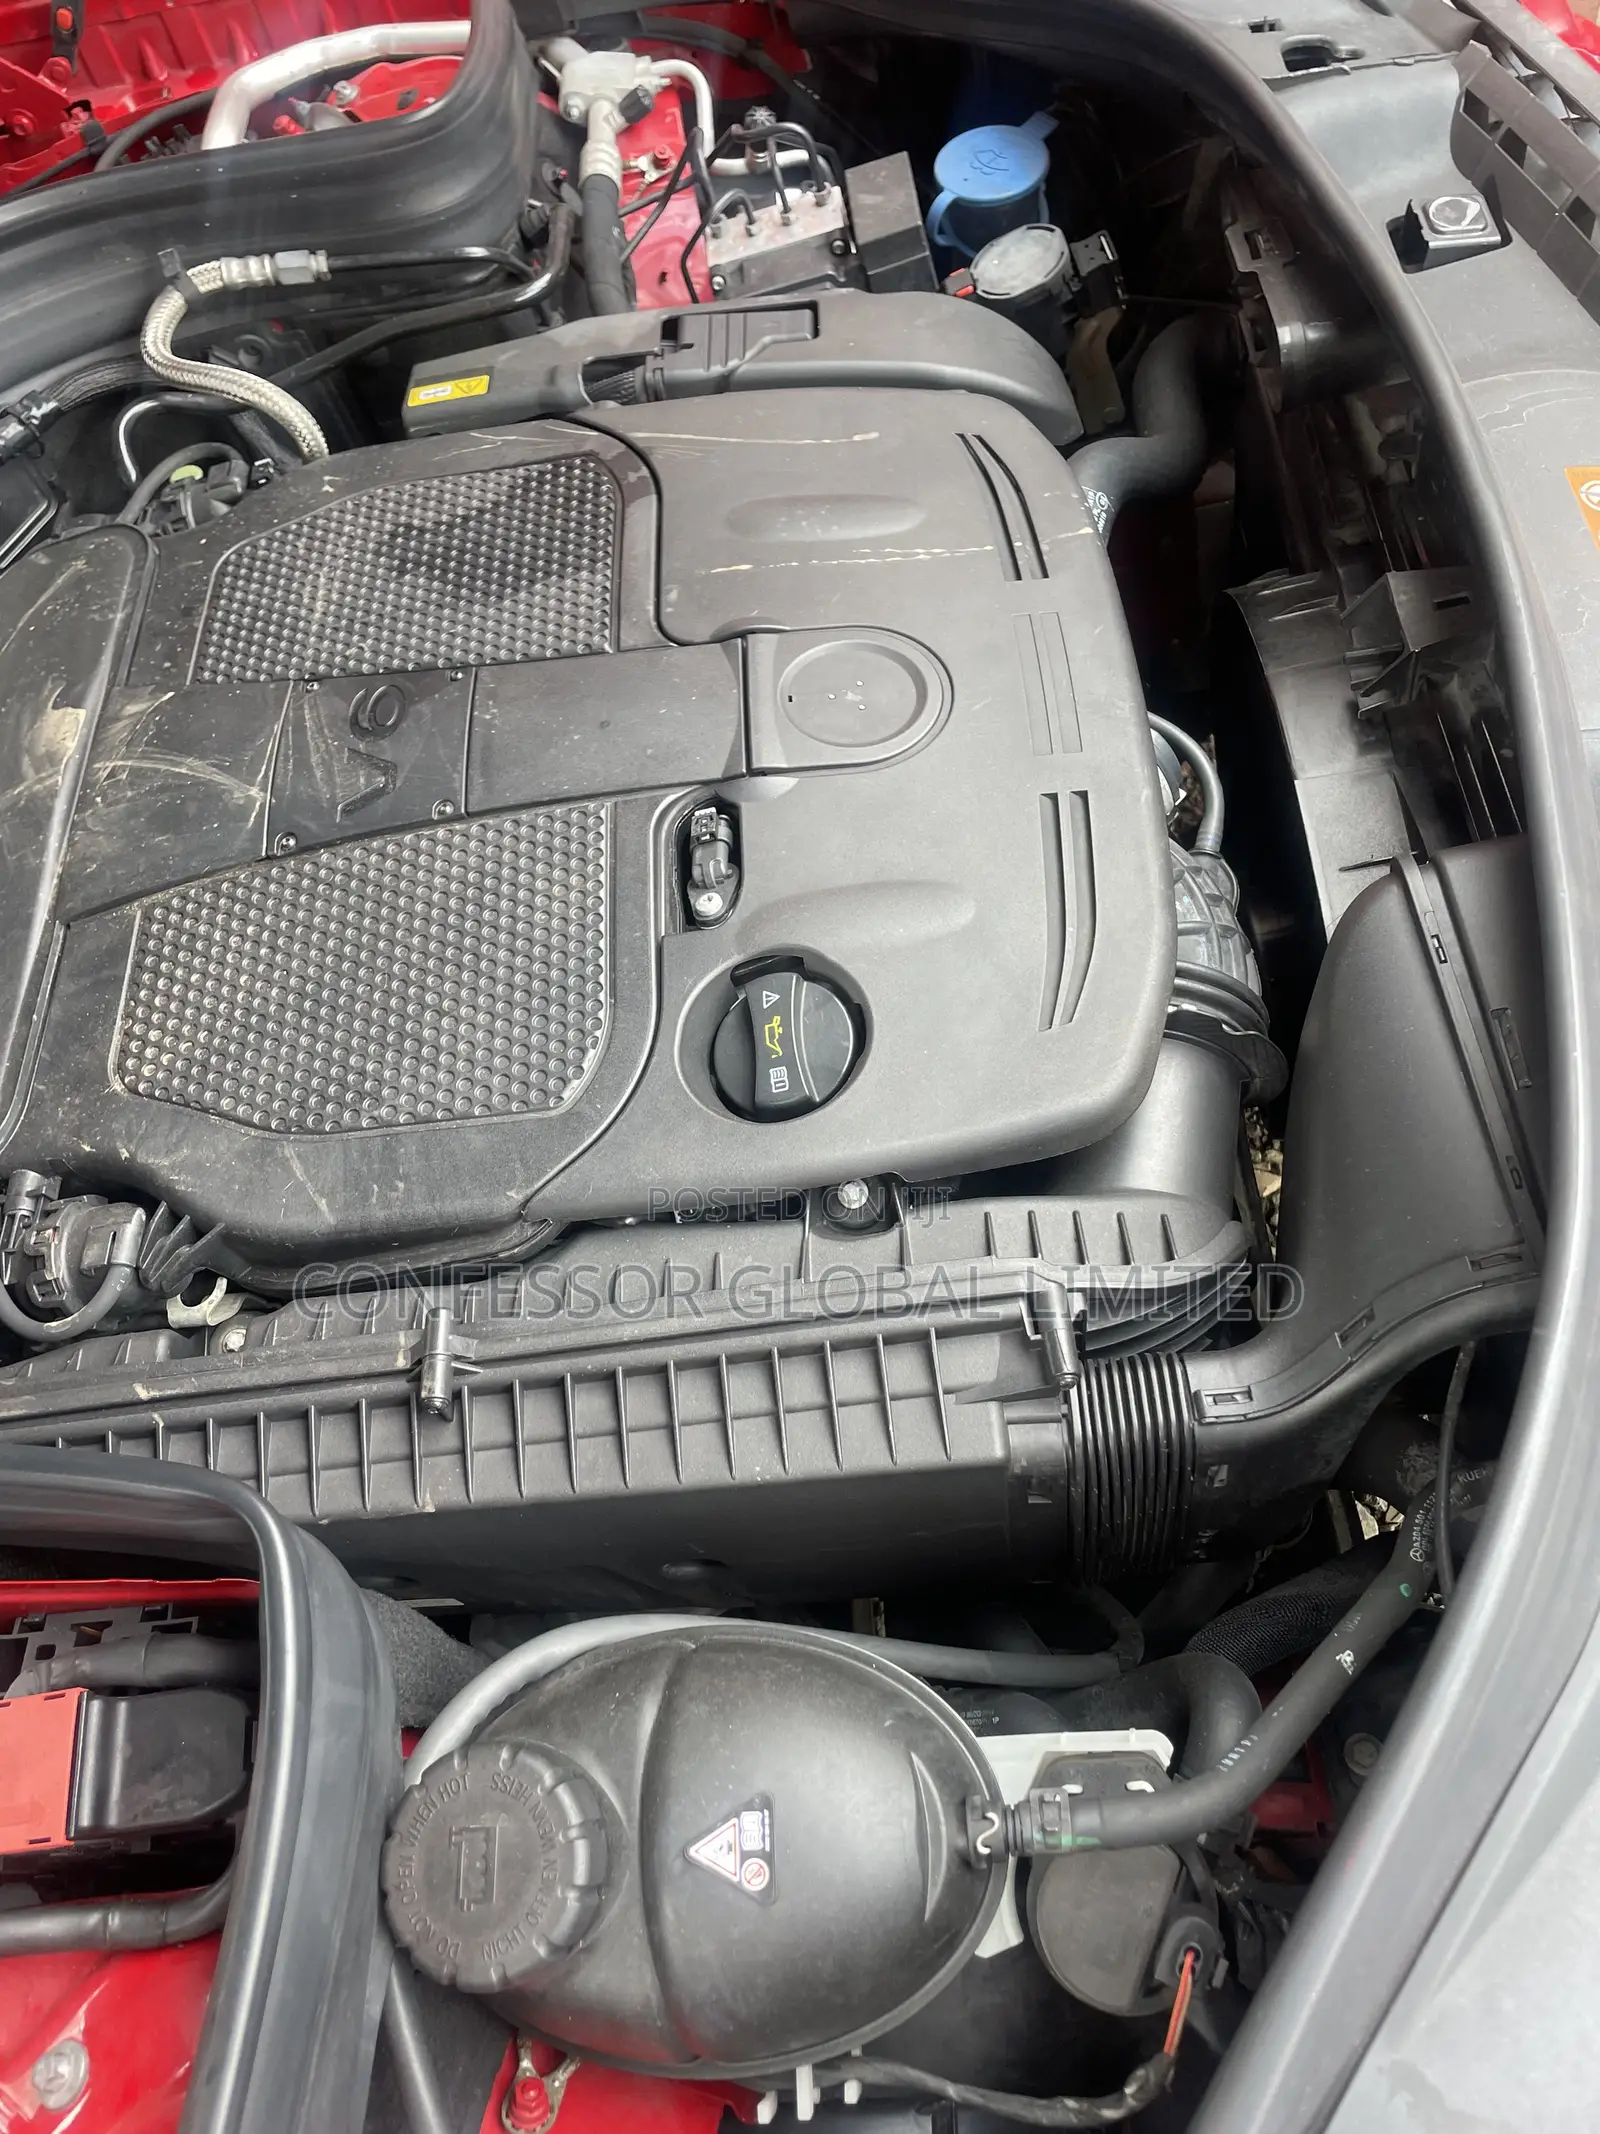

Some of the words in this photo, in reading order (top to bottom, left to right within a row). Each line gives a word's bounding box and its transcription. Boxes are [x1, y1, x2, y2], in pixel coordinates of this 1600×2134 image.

[437, 1772, 471, 1803] HOT
[490, 1772, 536, 1808] HEISS
[405, 1797, 440, 1848] WHEN
[530, 1799, 558, 1854] WENN
[398, 1853, 418, 1904] OPEN
[407, 1909, 439, 1942] NOT
[481, 1924, 528, 1961] NICHT
[436, 1936, 462, 1960] DO
